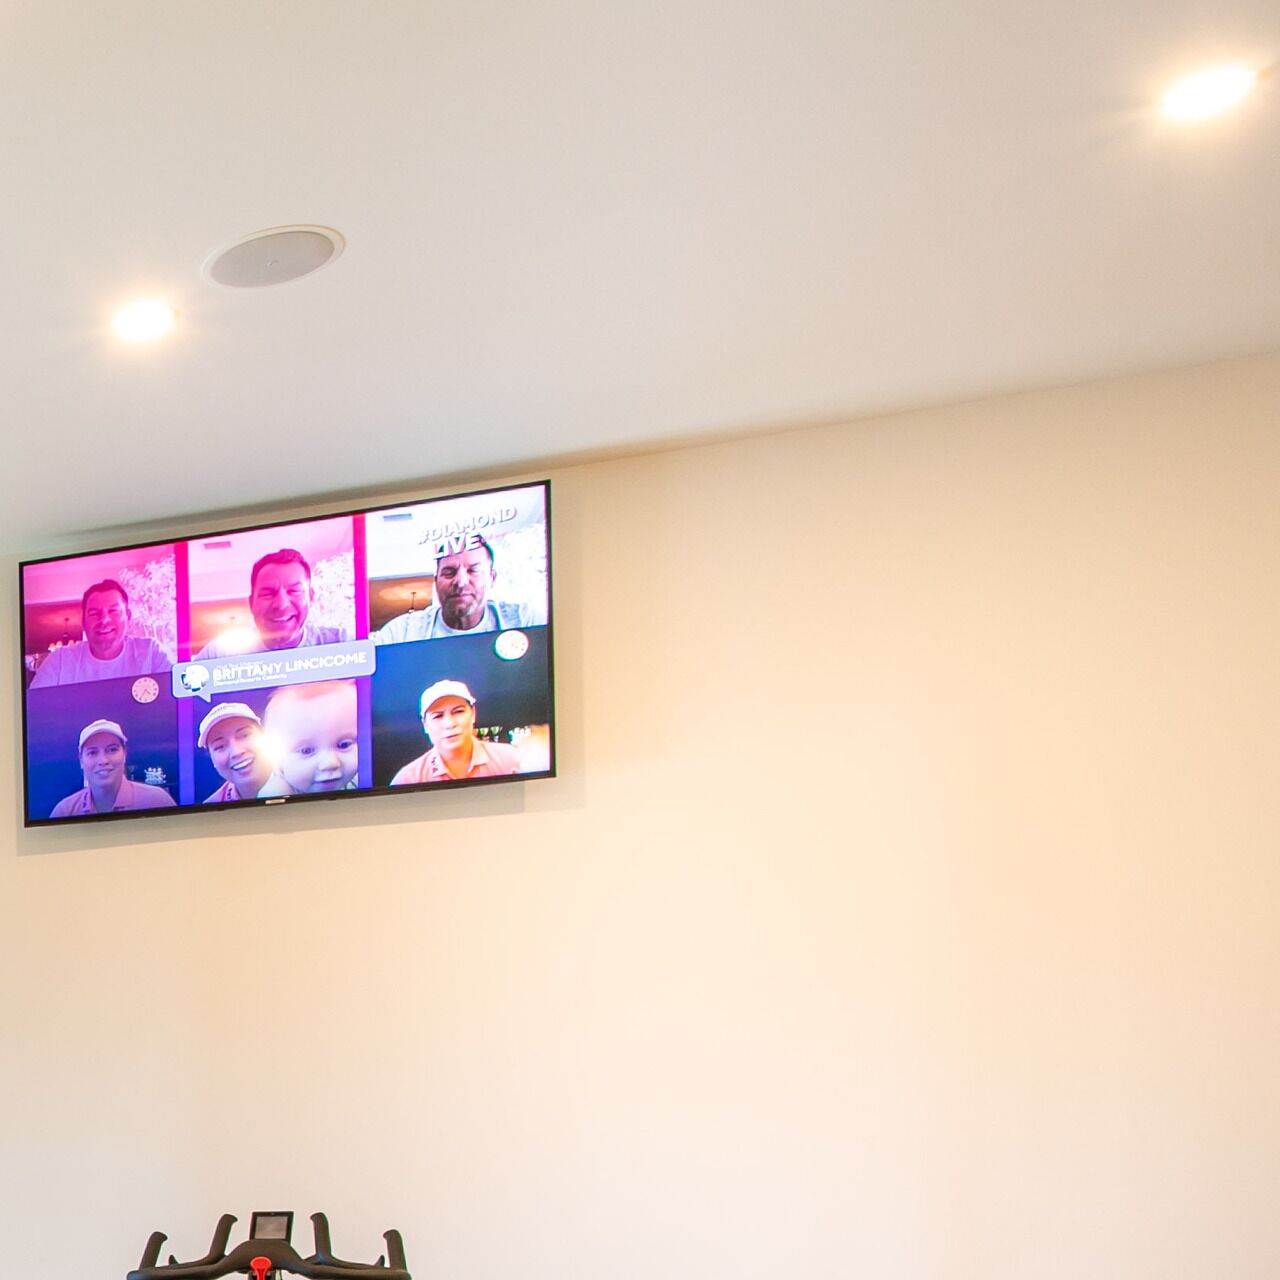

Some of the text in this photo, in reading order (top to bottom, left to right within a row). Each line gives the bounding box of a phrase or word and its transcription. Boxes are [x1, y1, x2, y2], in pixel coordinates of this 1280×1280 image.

[432, 533, 482, 561] LIVE
[212, 661, 283, 683] BRITTANY
[285, 651, 367, 673] LINCICOME
